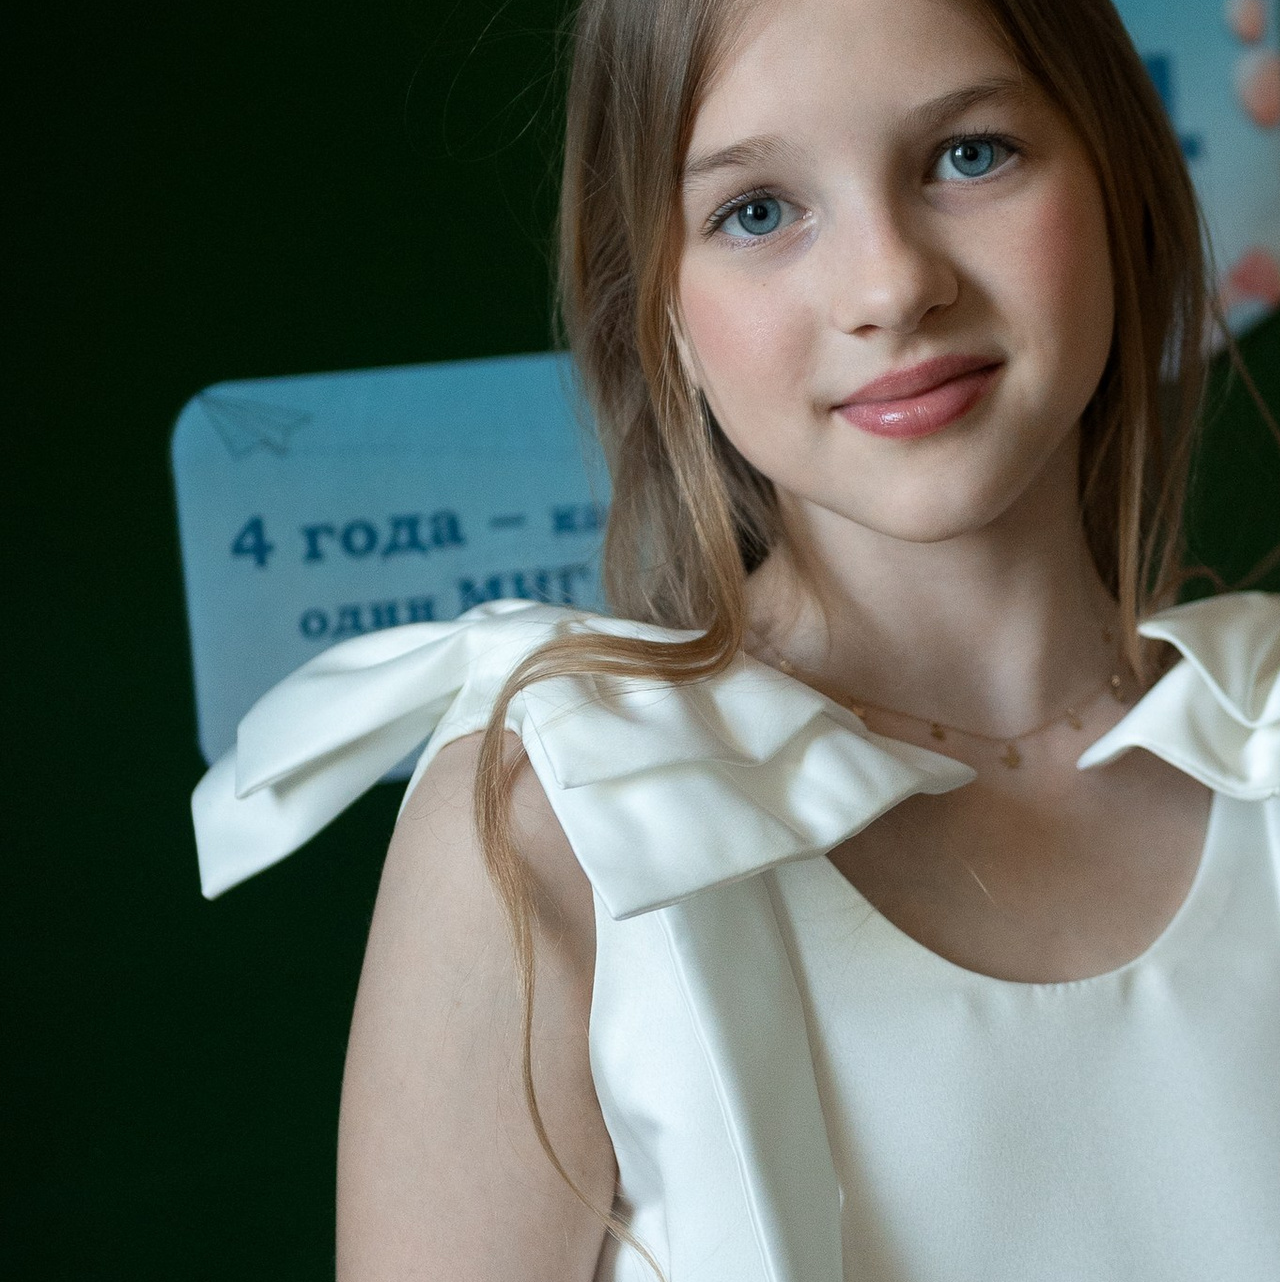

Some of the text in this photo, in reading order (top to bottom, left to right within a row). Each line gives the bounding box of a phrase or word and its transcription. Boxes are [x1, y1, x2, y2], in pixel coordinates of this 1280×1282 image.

[230, 514, 274, 569] 4
[301, 508, 466, 564] года
[299, 593, 436, 641] один
